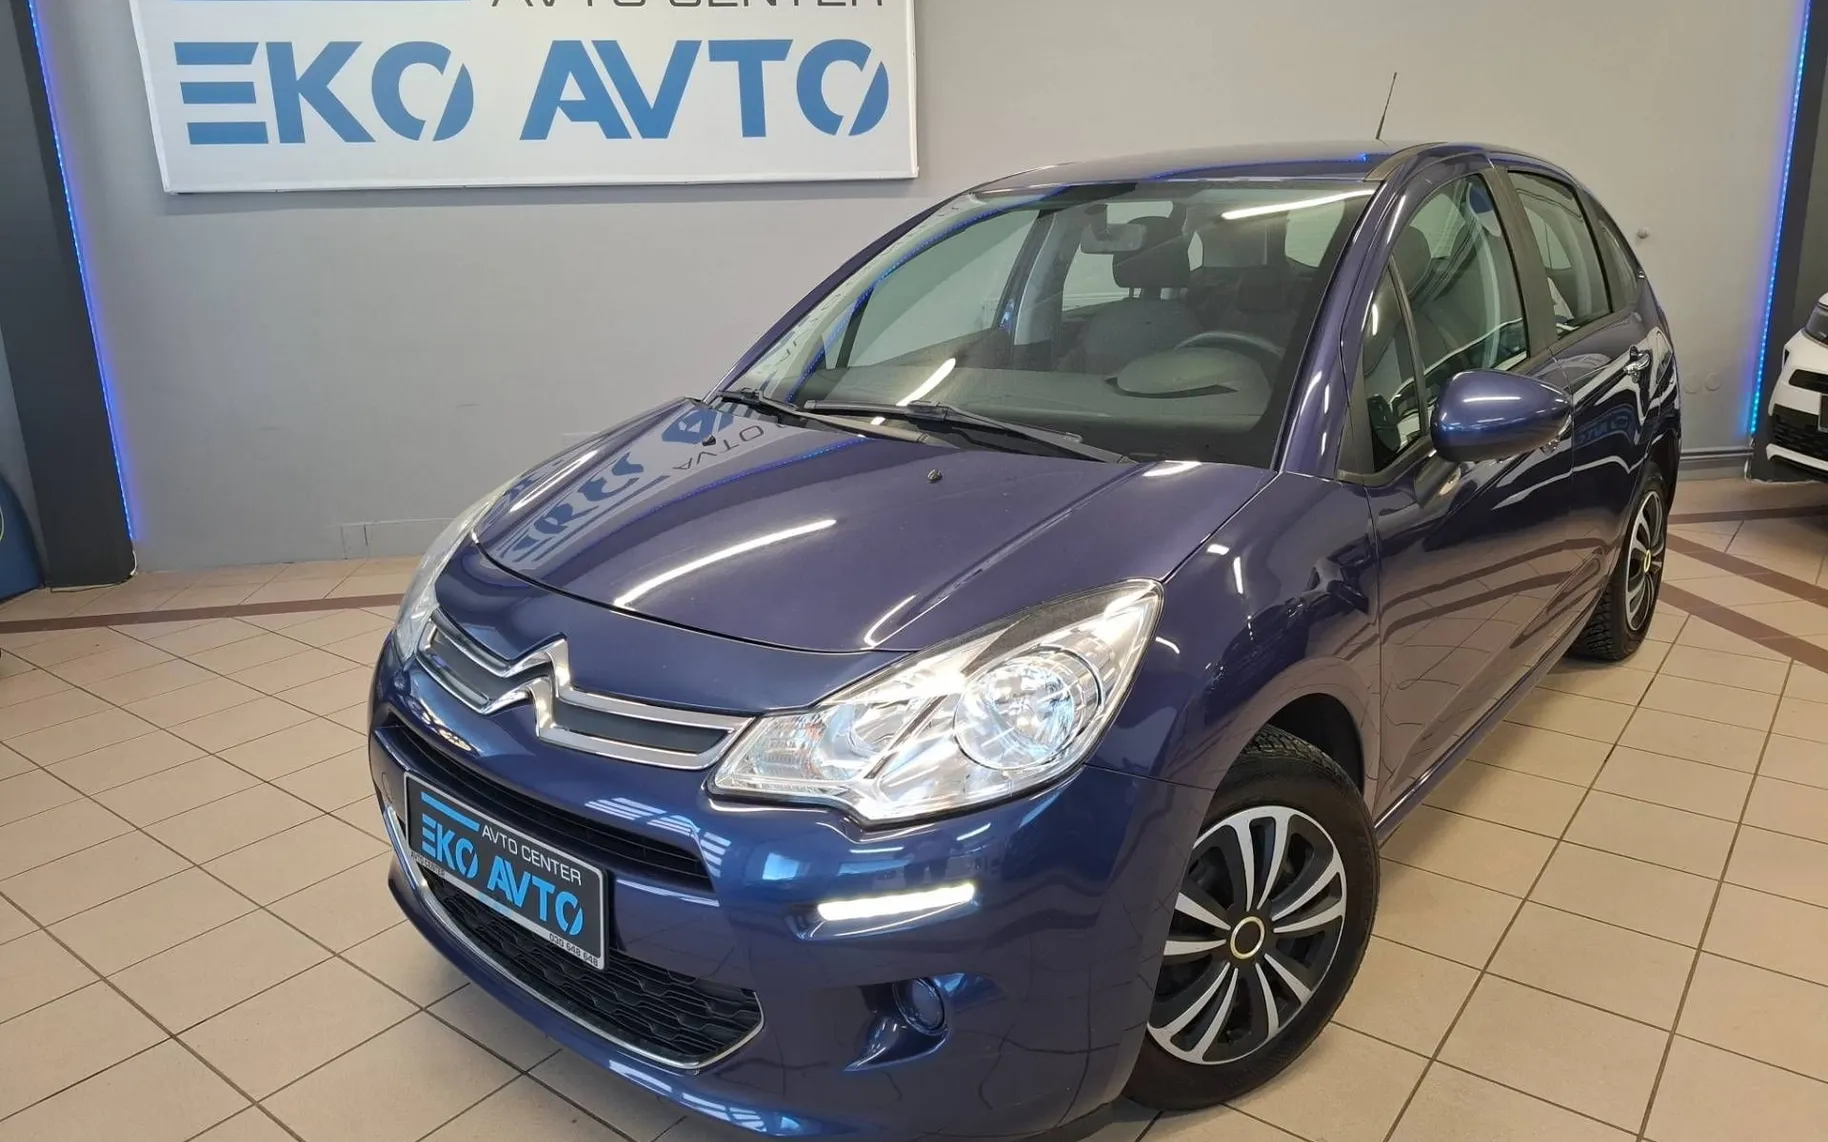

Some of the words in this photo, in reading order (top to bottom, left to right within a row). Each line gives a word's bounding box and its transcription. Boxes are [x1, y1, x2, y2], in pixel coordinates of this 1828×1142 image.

[174, 41, 474, 145] EKO
[519, 38, 889, 141] AVTO
[421, 812, 479, 880] EKO
[486, 855, 585, 936] AVTO
[482, 824, 518, 855] AVTO
[521, 845, 582, 886] CENTER
